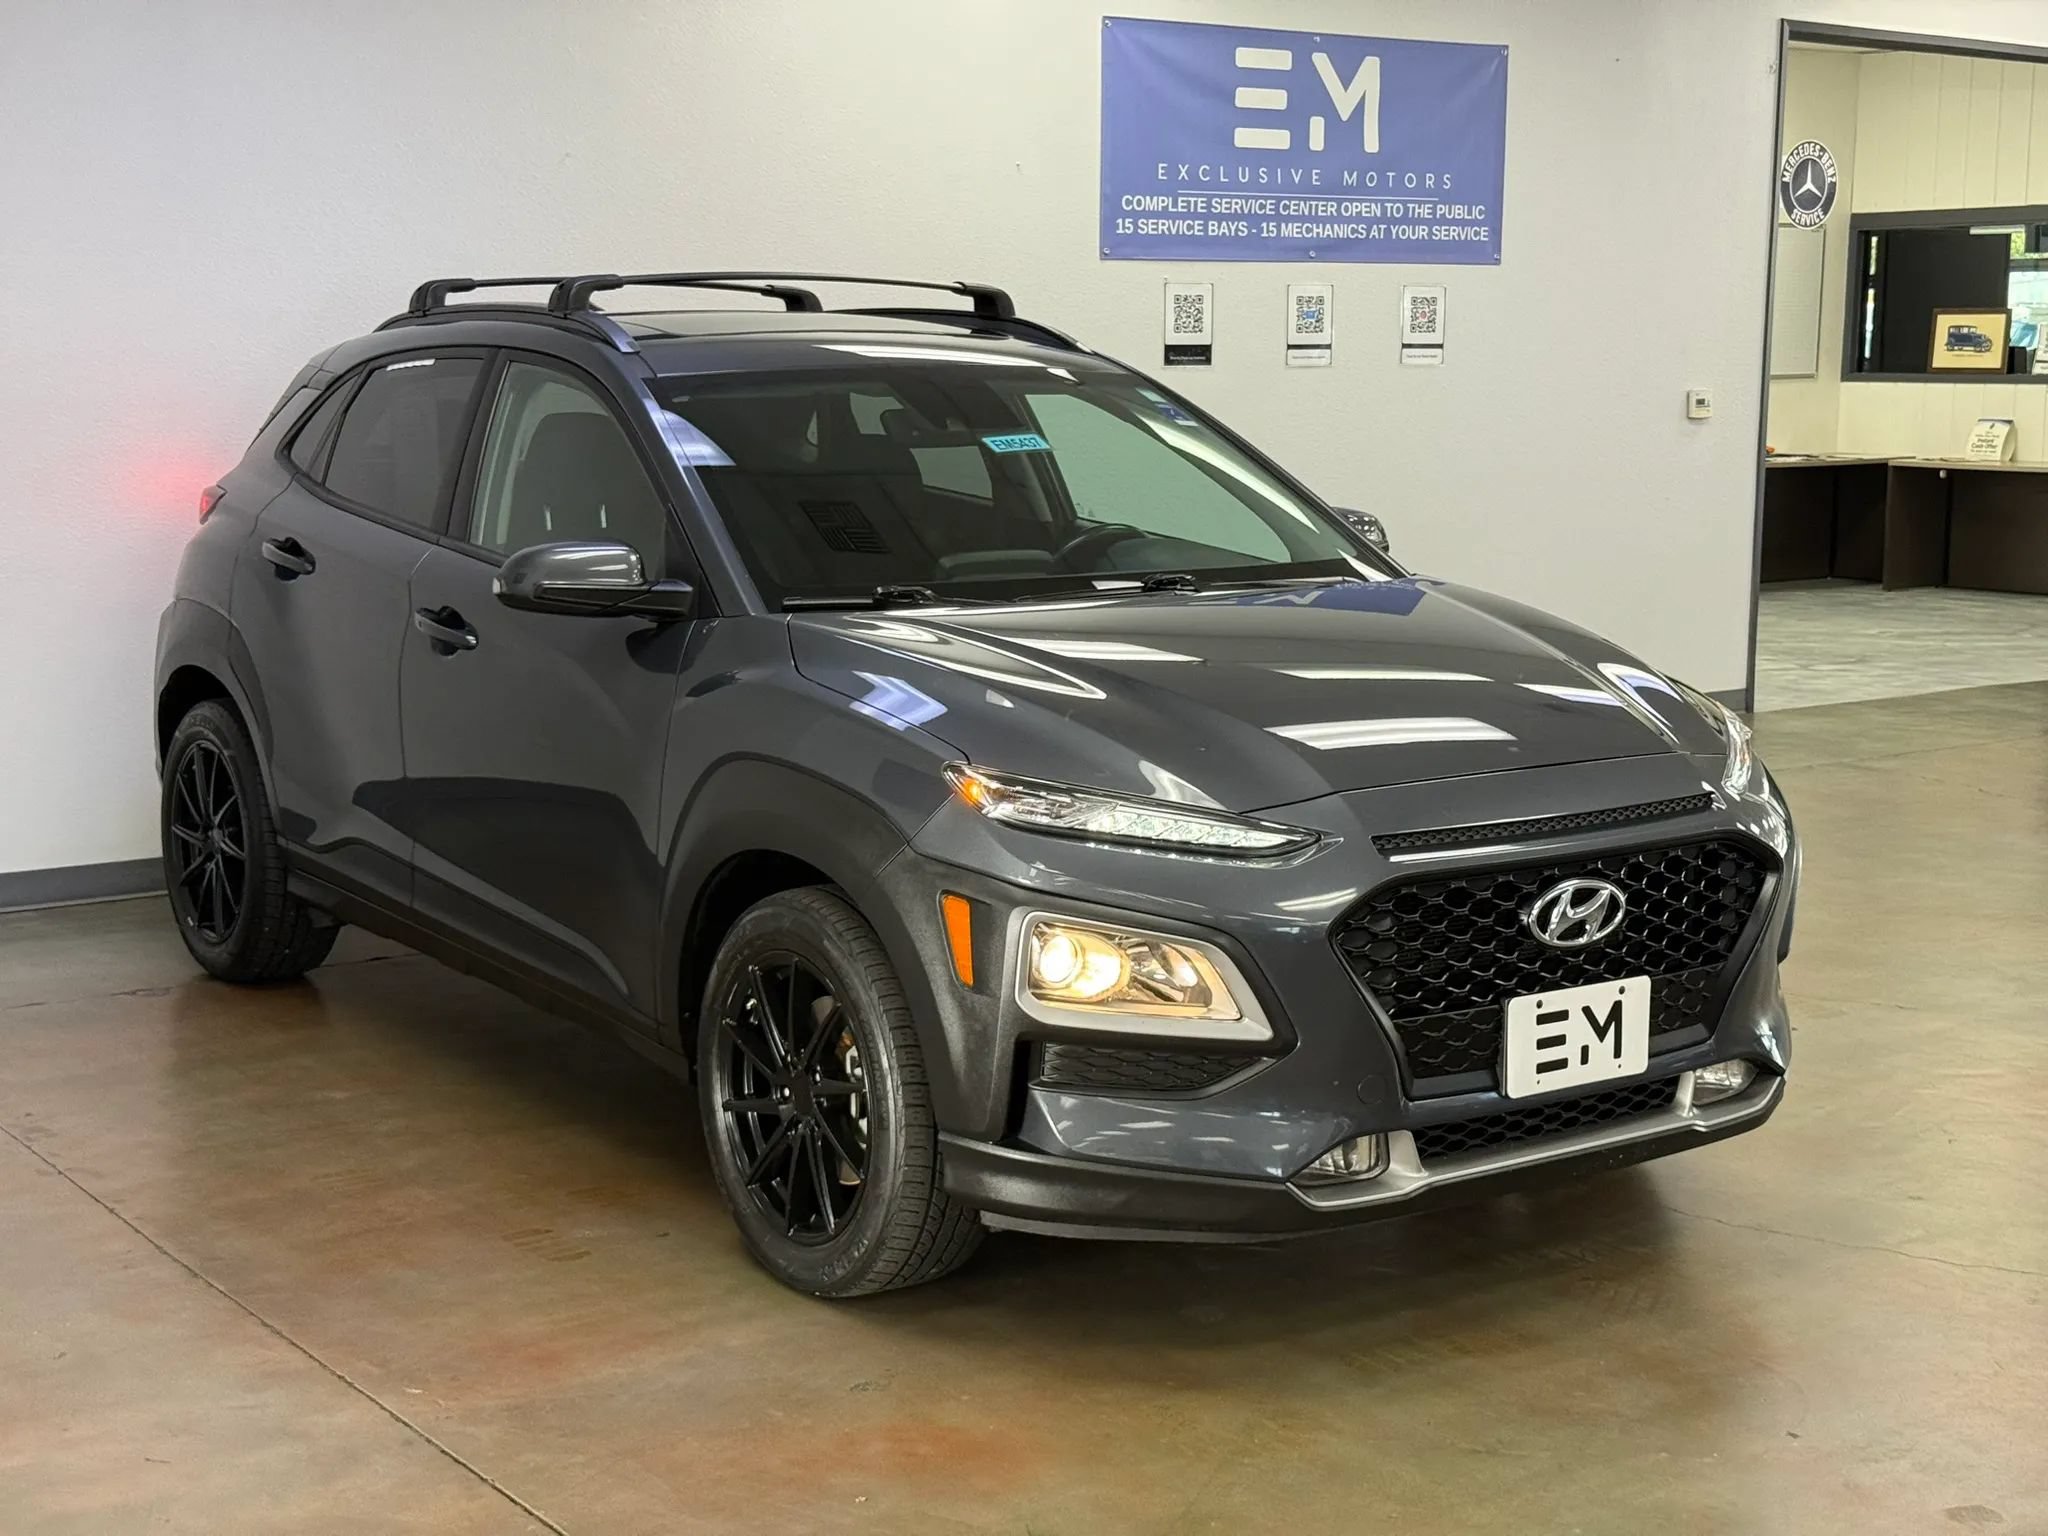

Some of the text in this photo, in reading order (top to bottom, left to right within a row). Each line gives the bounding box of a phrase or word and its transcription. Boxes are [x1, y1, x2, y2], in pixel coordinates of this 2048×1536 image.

[1234, 47, 1380, 153] EM
[1158, 163, 1451, 189] EXCLUSIVE MOTORS
[1782, 143, 1836, 183] MERCEDES-BENZ
[1121, 195, 1486, 219] COMPLETE SERVICE CENTER OPEN TO THE PUBLIC
[1791, 209, 1825, 226] SERVICE
[1116, 218, 1134, 234] 15
[1137, 219, 1204, 235] SERVICE
[1208, 220, 1248, 236] BAYS
[1260, 222, 1277, 237] 15
[1280, 223, 1367, 239] MECHANICS
[1369, 225, 1387, 239] AT
[1390, 225, 1429, 240] YOUR
[1432, 226, 1489, 241] SERVICE
[1536, 999, 1622, 1075] EM
